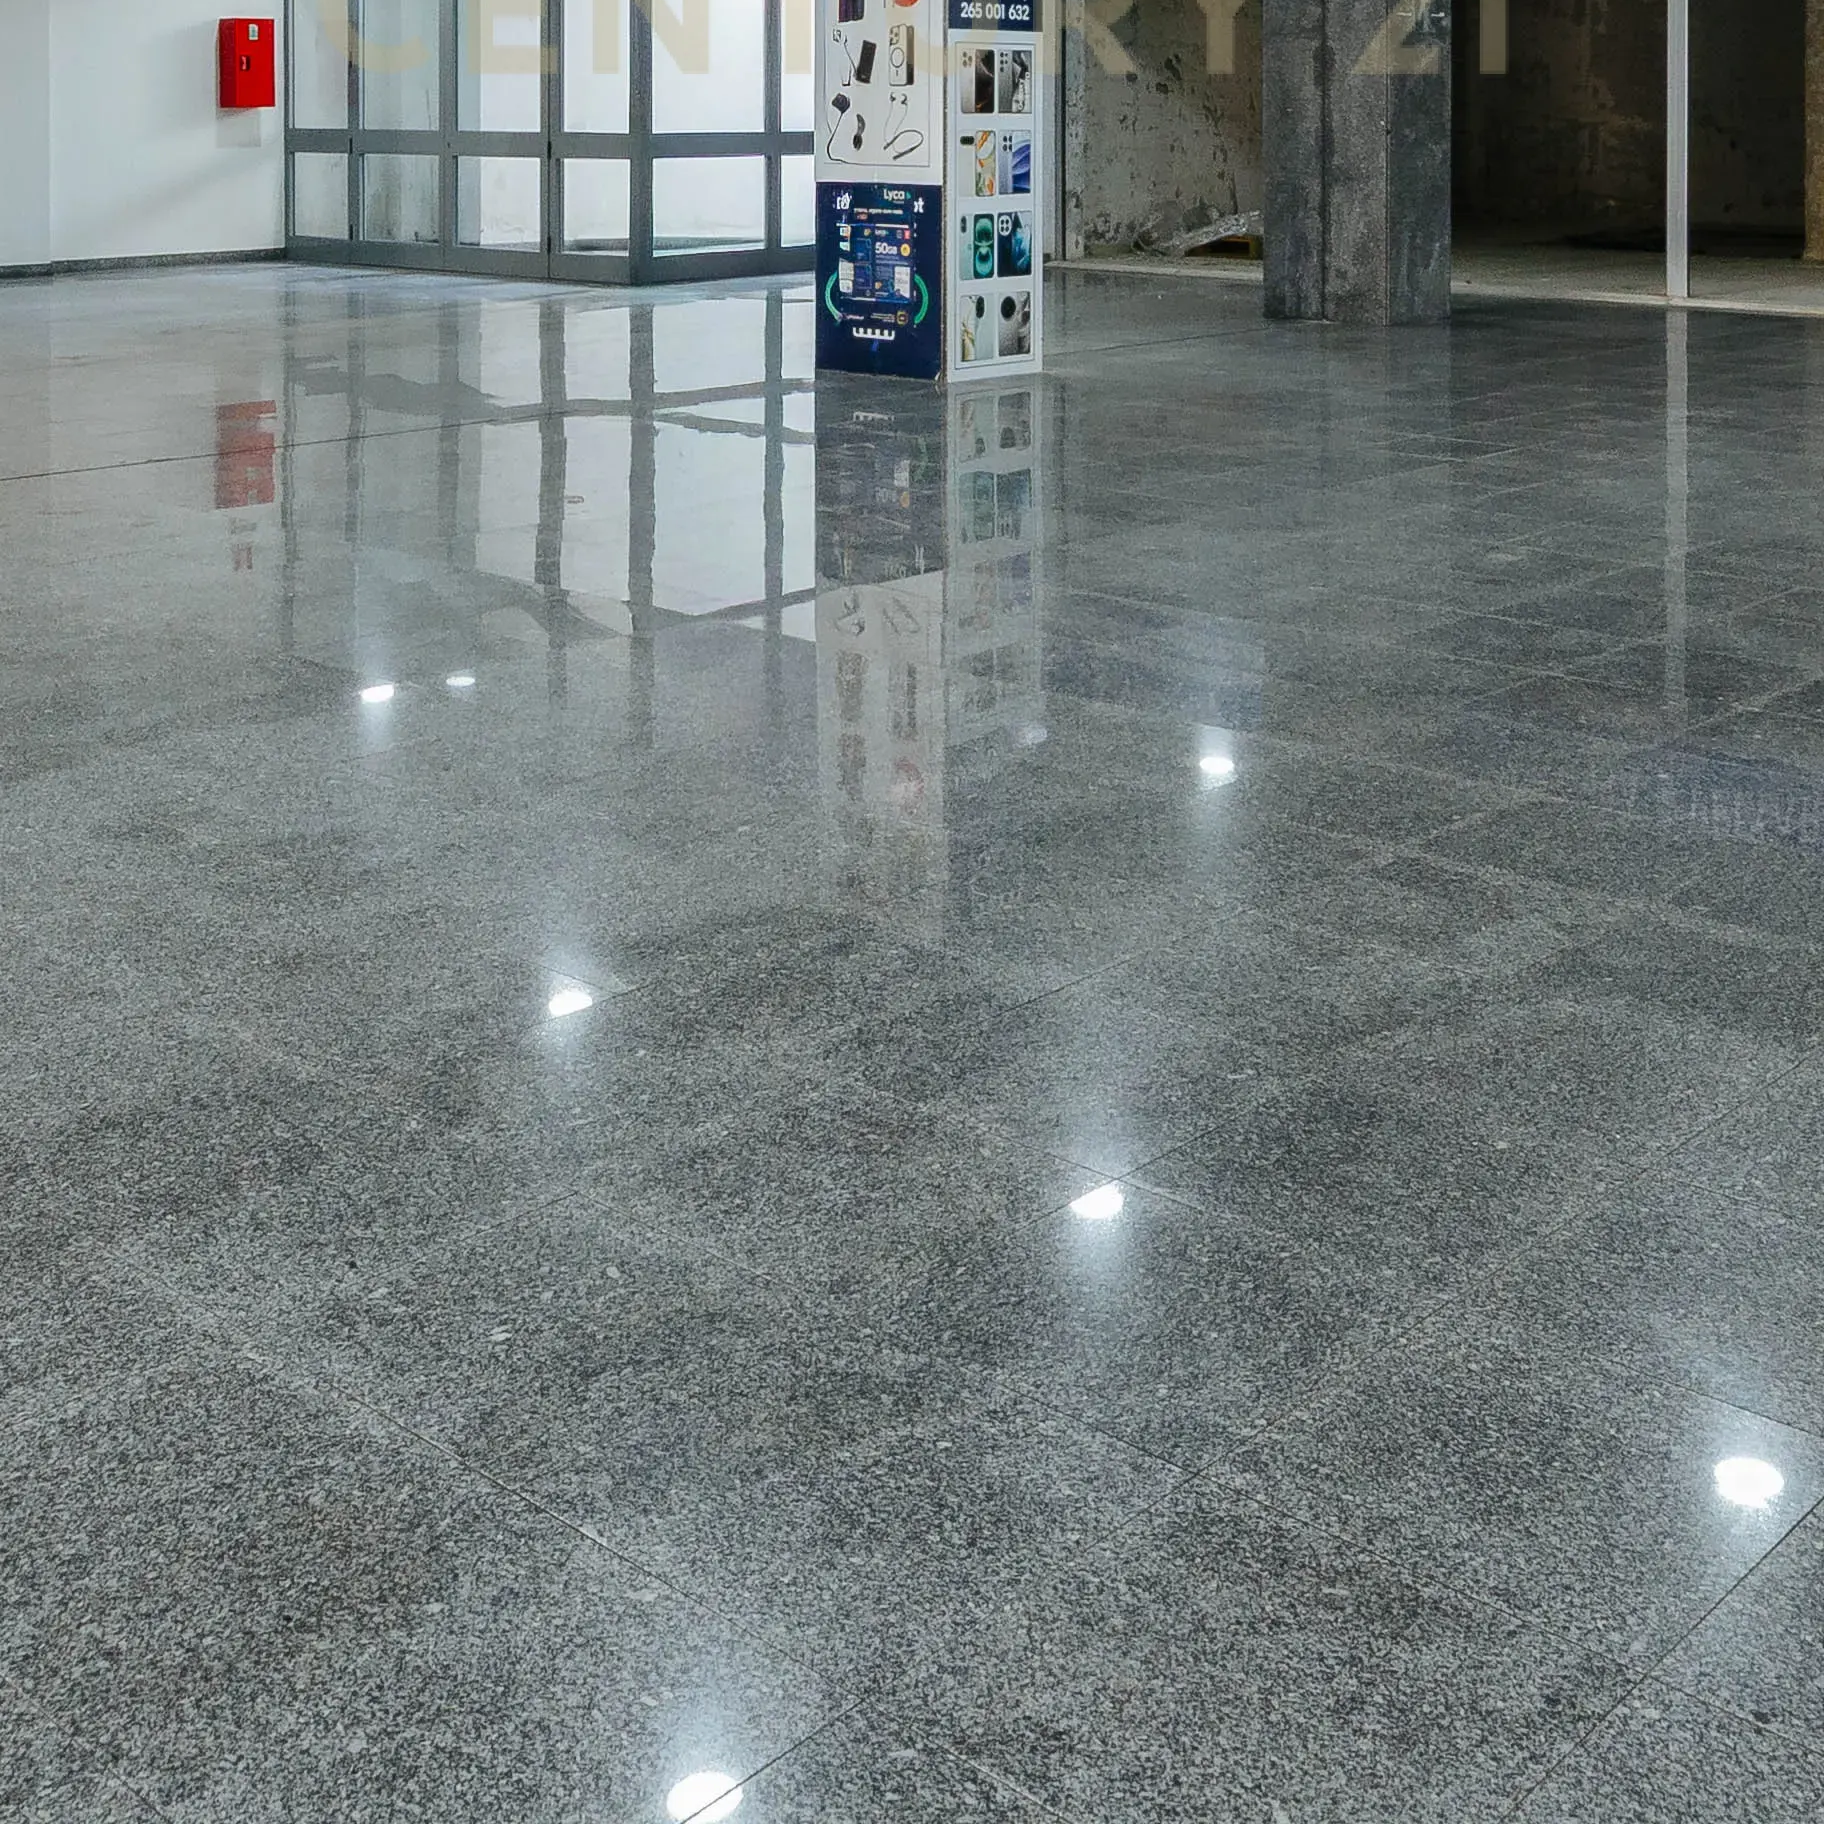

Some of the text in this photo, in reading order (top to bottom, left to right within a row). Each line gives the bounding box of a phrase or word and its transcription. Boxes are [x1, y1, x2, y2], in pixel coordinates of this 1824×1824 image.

[960, 2, 1030, 21] 265 001 632
[883, 188, 905, 202] Lyca
